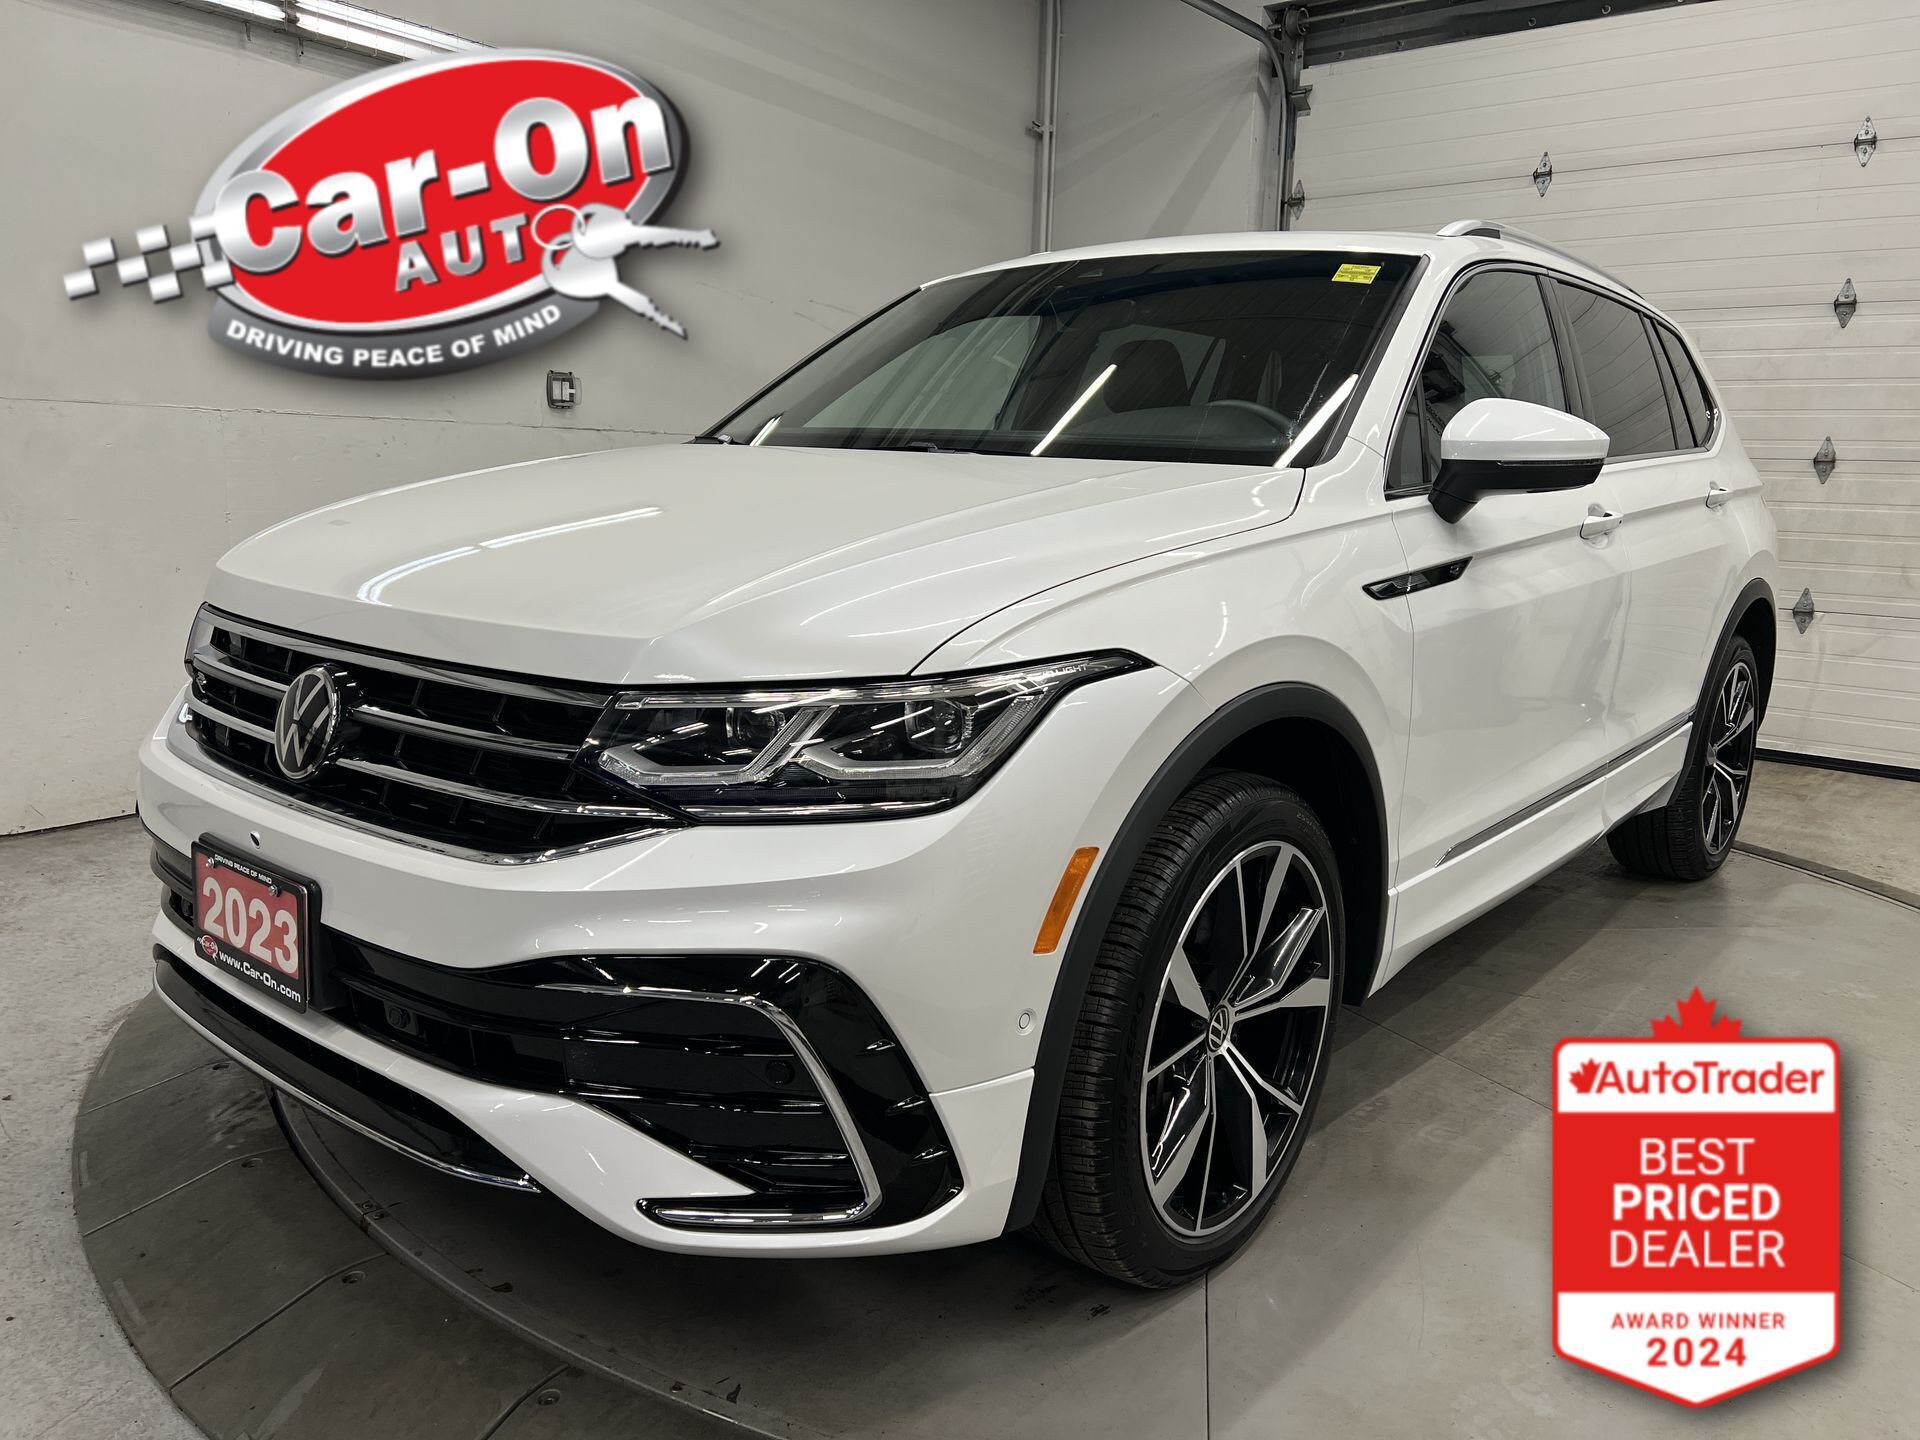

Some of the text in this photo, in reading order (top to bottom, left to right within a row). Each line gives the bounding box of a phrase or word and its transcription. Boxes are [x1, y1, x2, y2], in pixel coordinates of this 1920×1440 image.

[233, 862, 250, 875] PEACE
[250, 869, 258, 878] OF
[258, 873, 272, 884] MIND
[202, 876, 299, 975] 2023
[218, 950, 302, 1004] www.Car-On.com
